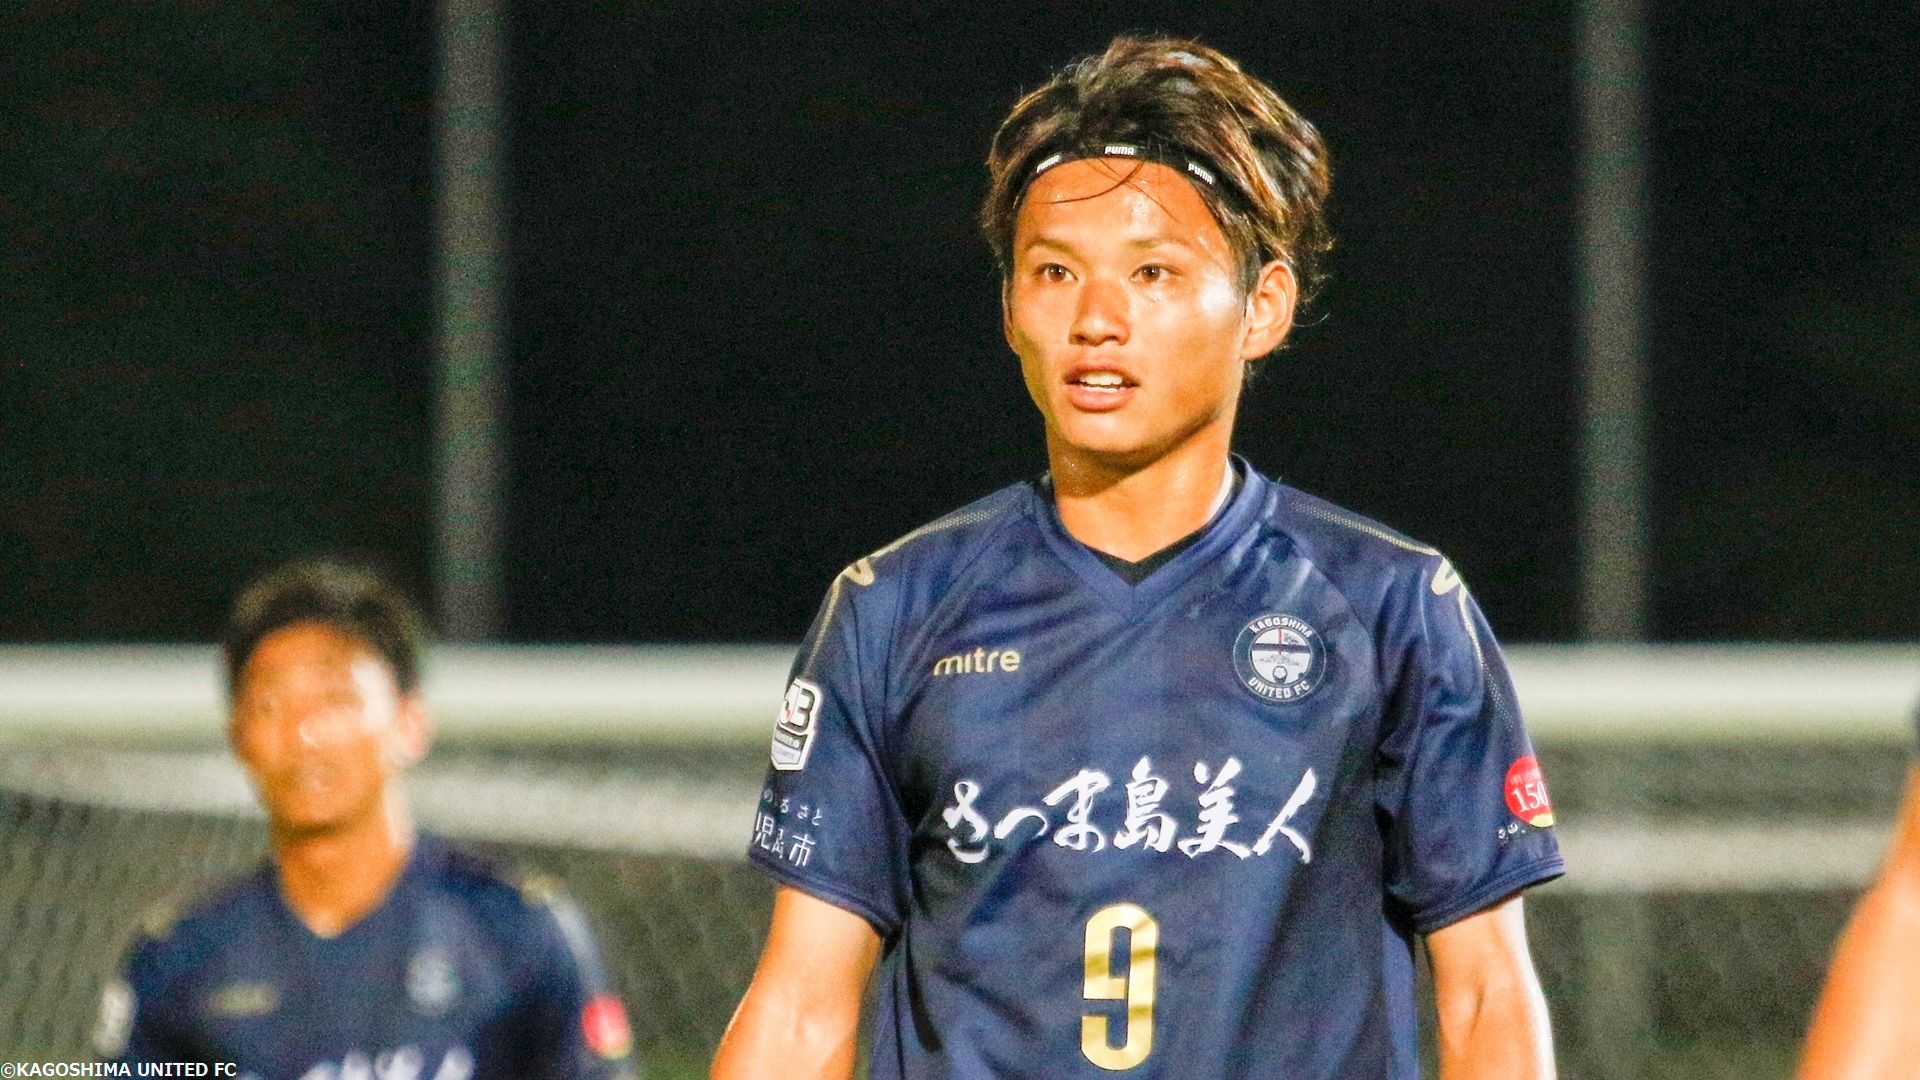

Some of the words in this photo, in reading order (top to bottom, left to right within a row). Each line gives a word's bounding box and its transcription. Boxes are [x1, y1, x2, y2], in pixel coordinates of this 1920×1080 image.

[1104, 146, 1135, 156] PUMA
[1187, 162, 1214, 185] PUMA
[1248, 616, 1314, 639] KAGOSHIMA
[933, 647, 1021, 676] mitre
[1248, 677, 1292, 699] UNITED
[1293, 680, 1310, 697] FC
[942, 756, 1317, 864] さつま島美人
[1080, 902, 1158, 1071] 9
